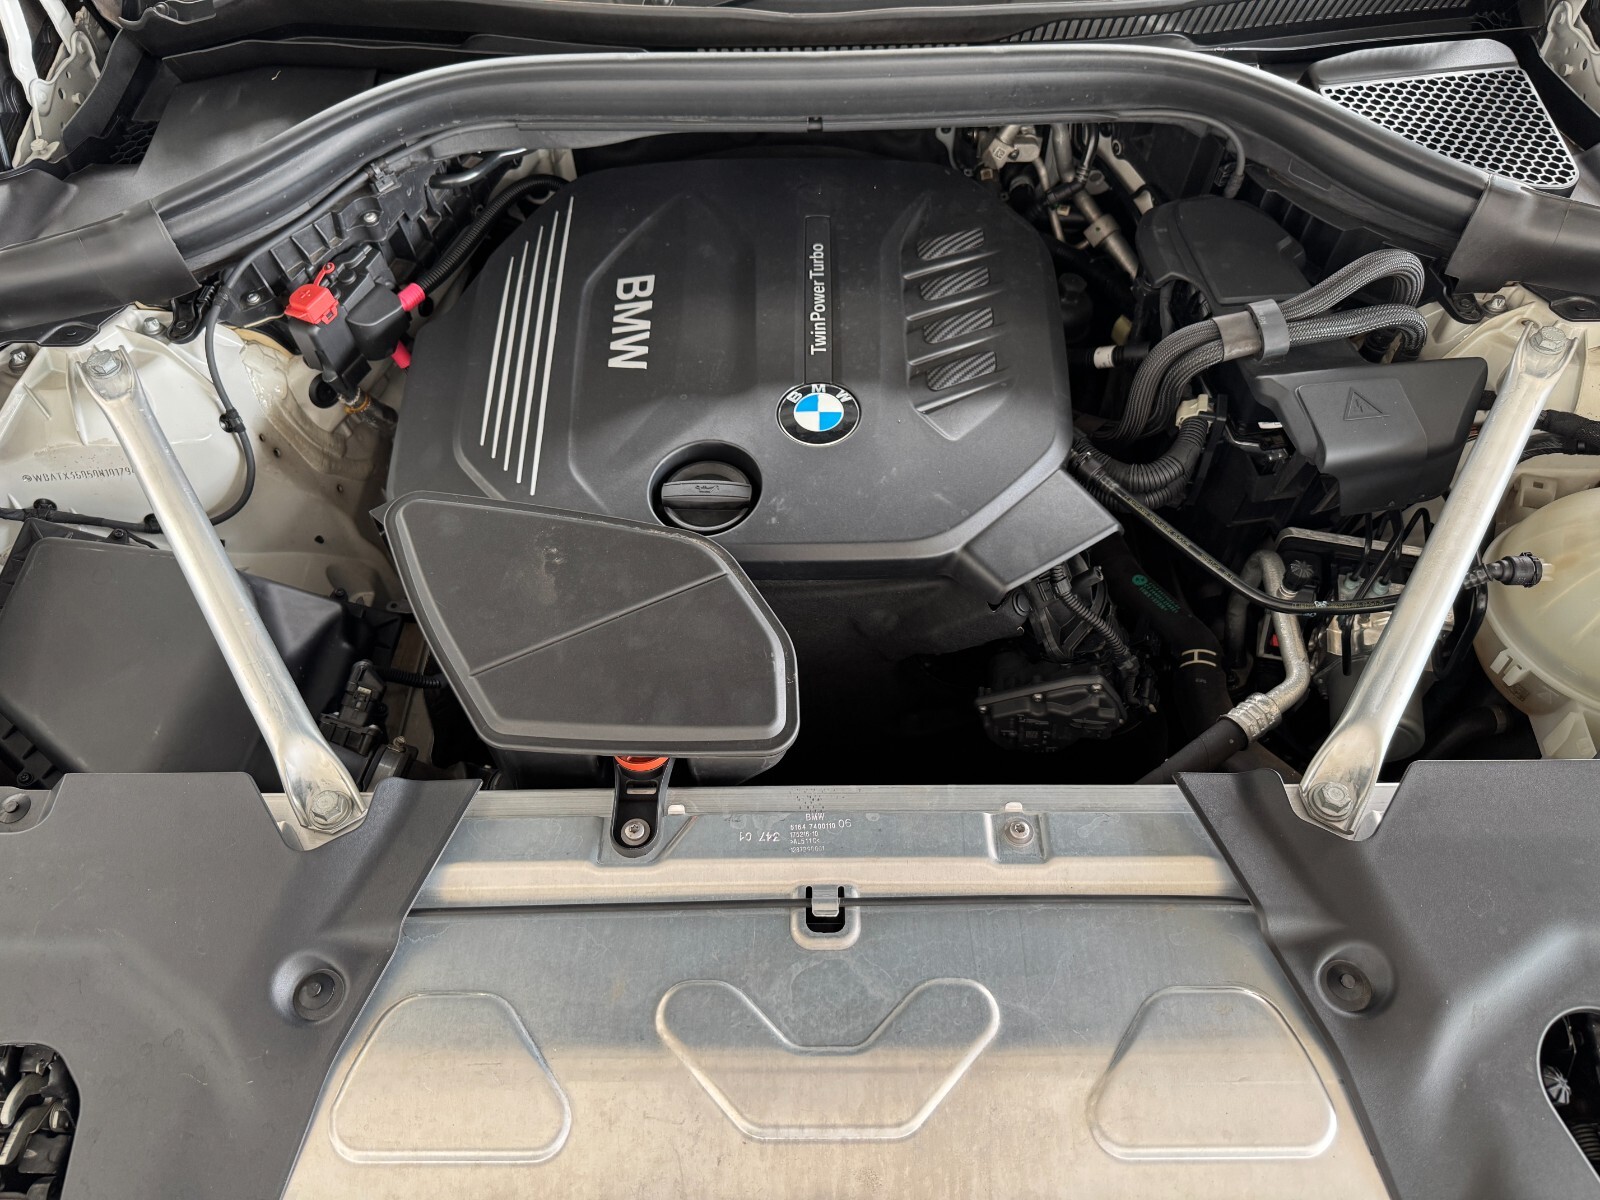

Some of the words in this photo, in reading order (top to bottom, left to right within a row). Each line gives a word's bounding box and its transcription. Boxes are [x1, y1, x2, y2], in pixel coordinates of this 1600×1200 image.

[808, 242, 825, 279] Turbo
[607, 274, 656, 370] BMW
[809, 279, 827, 356] TwinPower
[785, 383, 852, 404] BMW
[805, 813, 825, 821] BMW
[808, 822, 836, 830] 7400110
[838, 818, 852, 829] 06
[758, 831, 781, 842] 347
